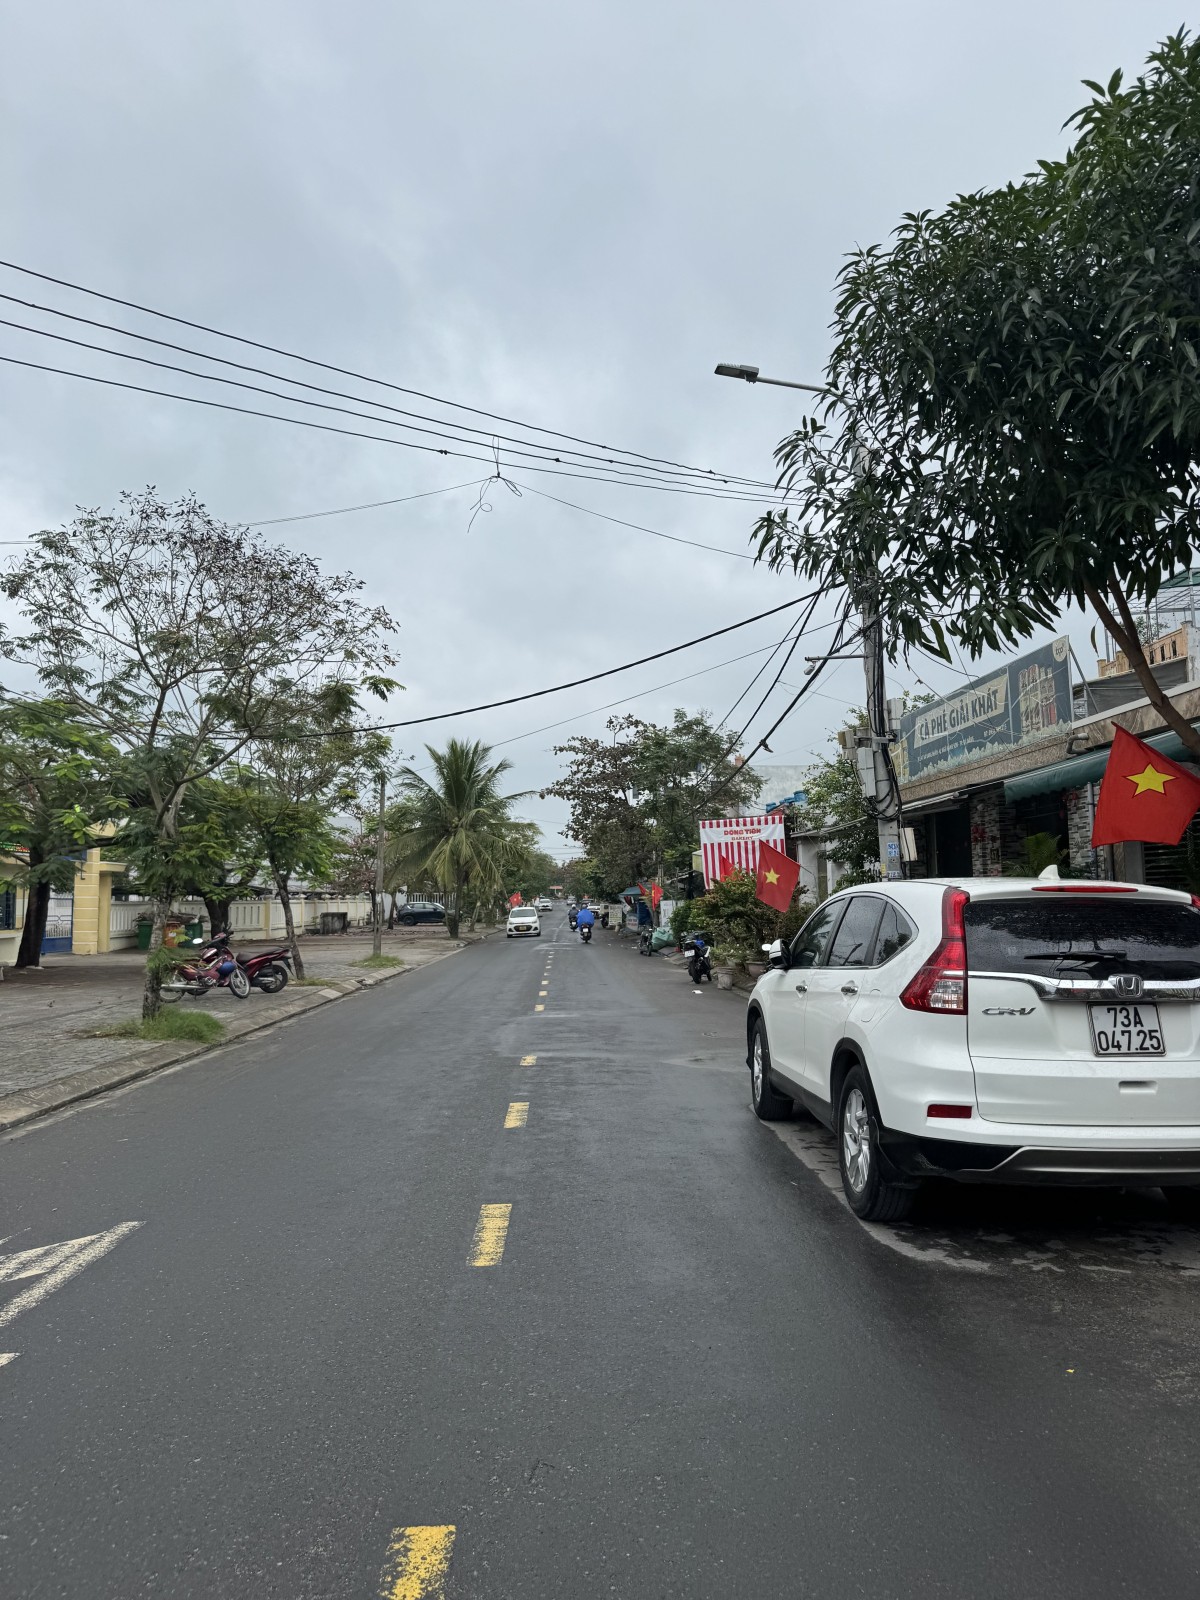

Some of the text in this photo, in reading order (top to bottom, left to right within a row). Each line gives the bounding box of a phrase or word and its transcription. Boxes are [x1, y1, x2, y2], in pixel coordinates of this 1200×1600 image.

[920, 718, 930, 741] CÀ
[949, 699, 970, 728] GIẢI
[971, 688, 999, 719] KHÁT
[1106, 1007, 1144, 1029] 73A
[1097, 1029, 1162, 1052] 047.25
